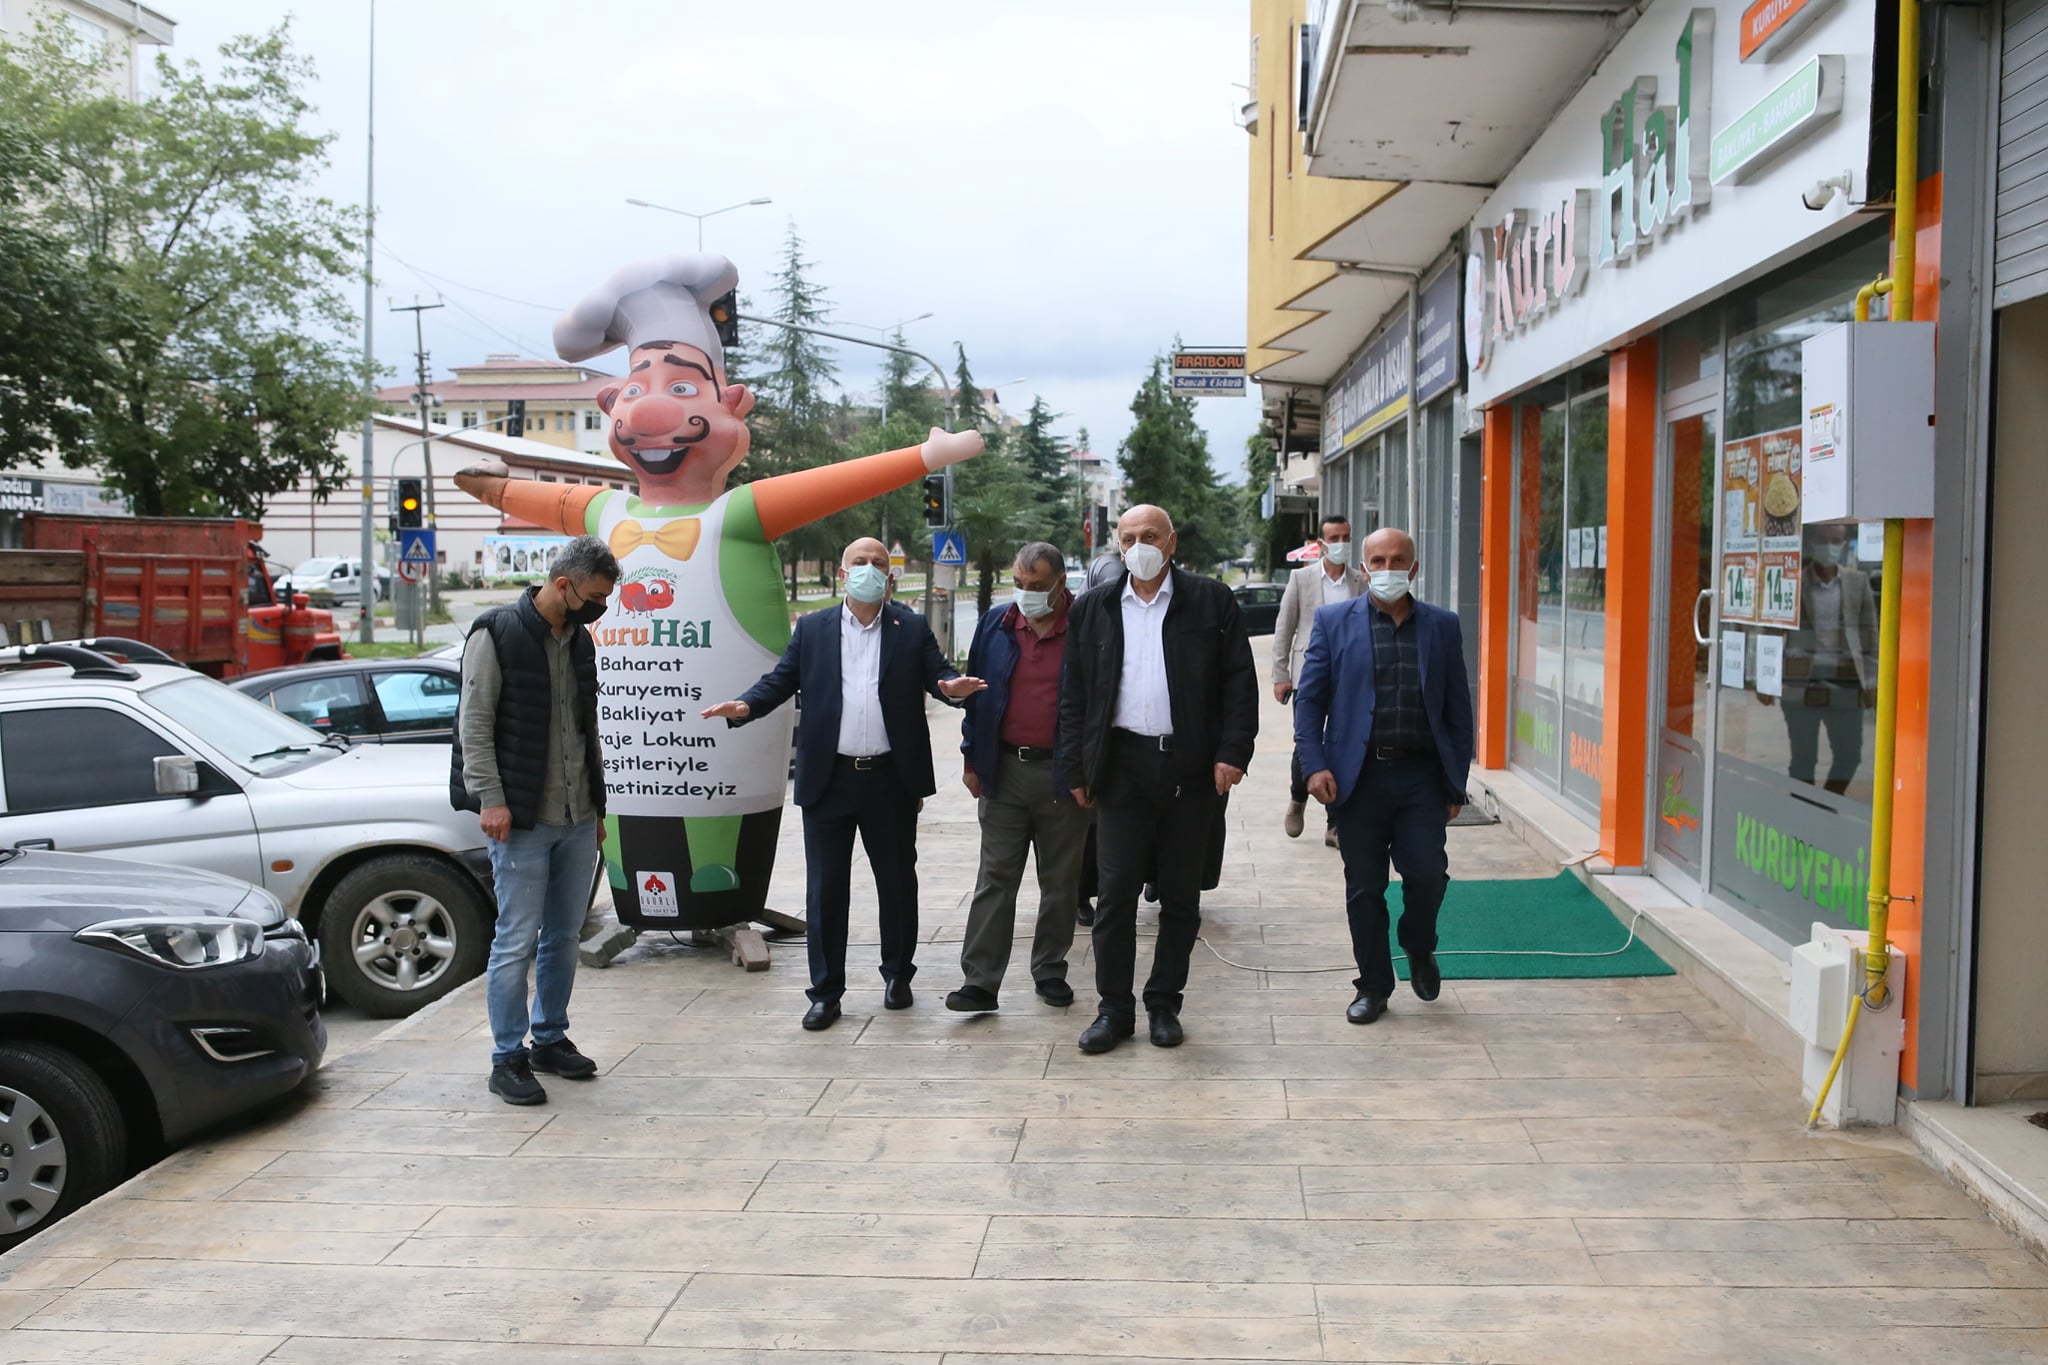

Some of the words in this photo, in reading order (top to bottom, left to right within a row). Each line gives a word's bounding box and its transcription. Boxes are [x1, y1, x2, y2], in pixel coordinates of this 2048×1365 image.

[1763, 82, 1809, 134] BAHARAT
[1491, 190, 1581, 340] Kuru
[1176, 356, 1244, 367] FIRATBORU
[0, 495, 44, 512] NMAZ
[601, 656, 684, 672] Baharat
[597, 682, 702, 700] Kuruyemiş
[602, 705, 686, 725] Bakliyat
[600, 732, 632, 749] raje
[643, 731, 716, 748] Lokum
[603, 755, 709, 776] eşitleriyle
[1570, 731, 1603, 782] BAHA
[605, 781, 737, 800] metinizdeyiz
[1736, 811, 1870, 929] KURUYEMİ
